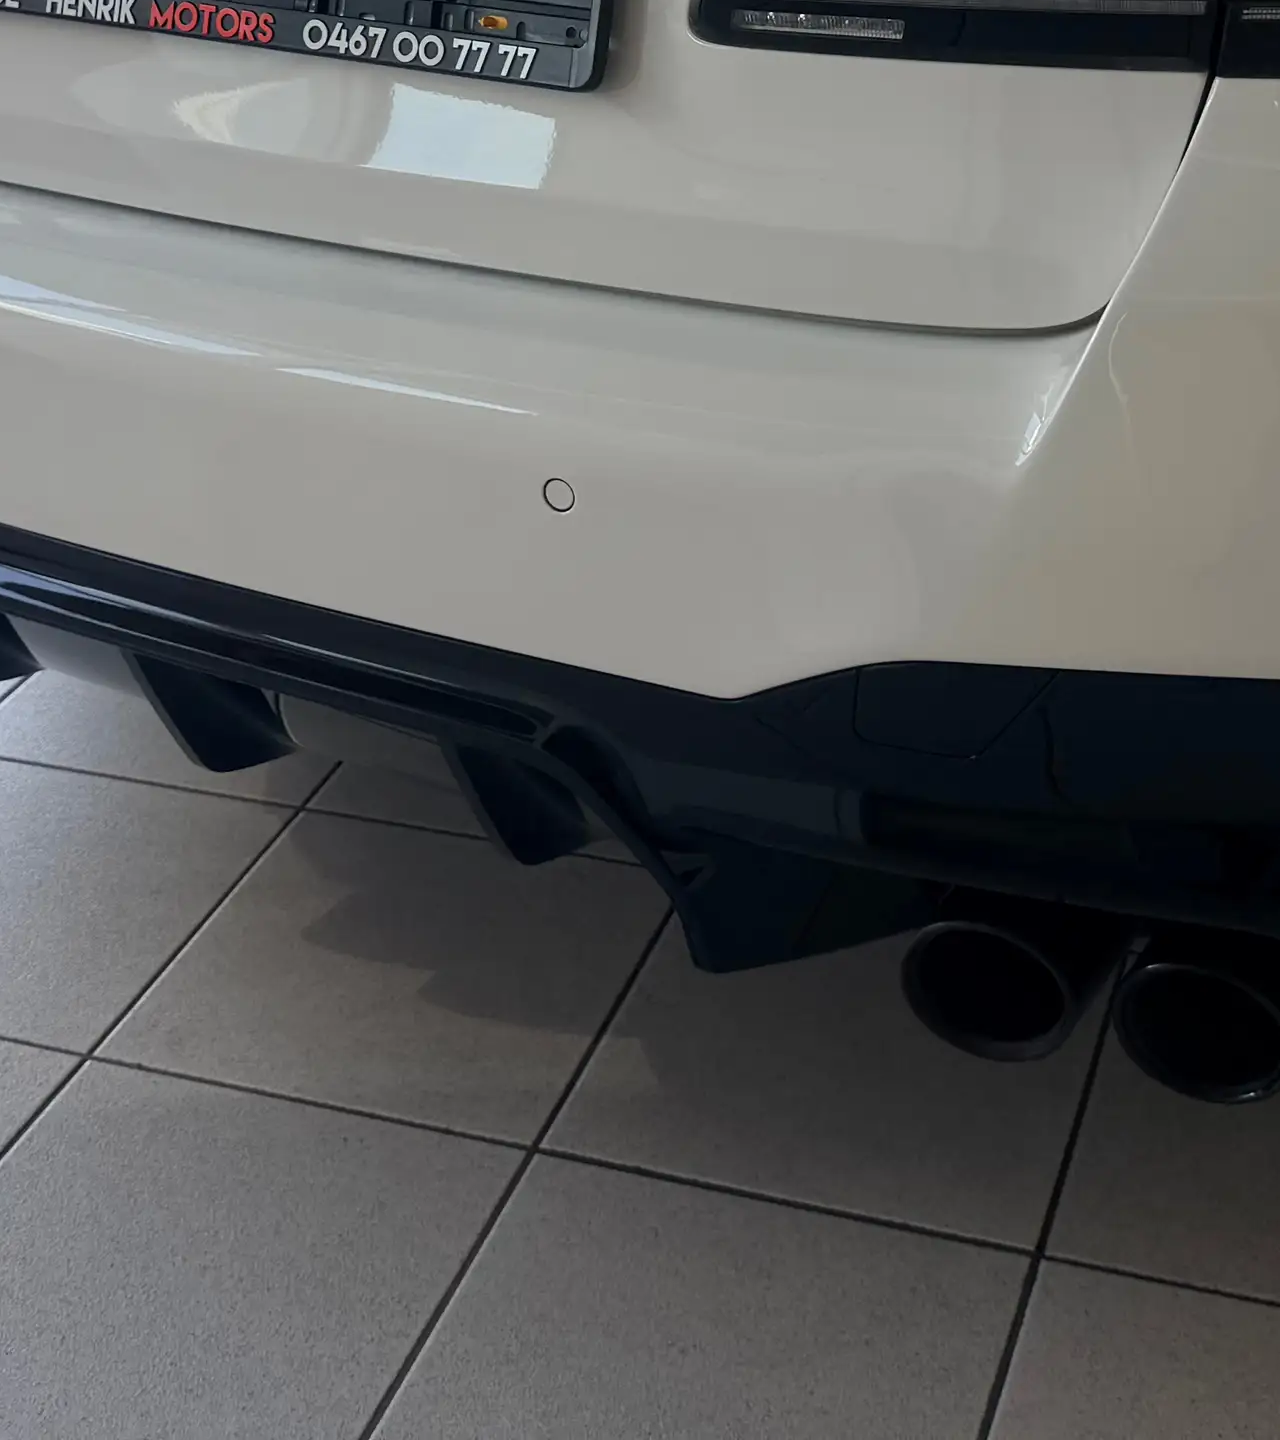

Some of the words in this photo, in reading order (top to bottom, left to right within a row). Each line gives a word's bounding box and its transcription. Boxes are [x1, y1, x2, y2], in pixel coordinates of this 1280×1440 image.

[302, 18, 387, 58] 0467
[392, 31, 445, 66] 00
[452, 38, 491, 73] 77
[498, 44, 537, 79] 77
